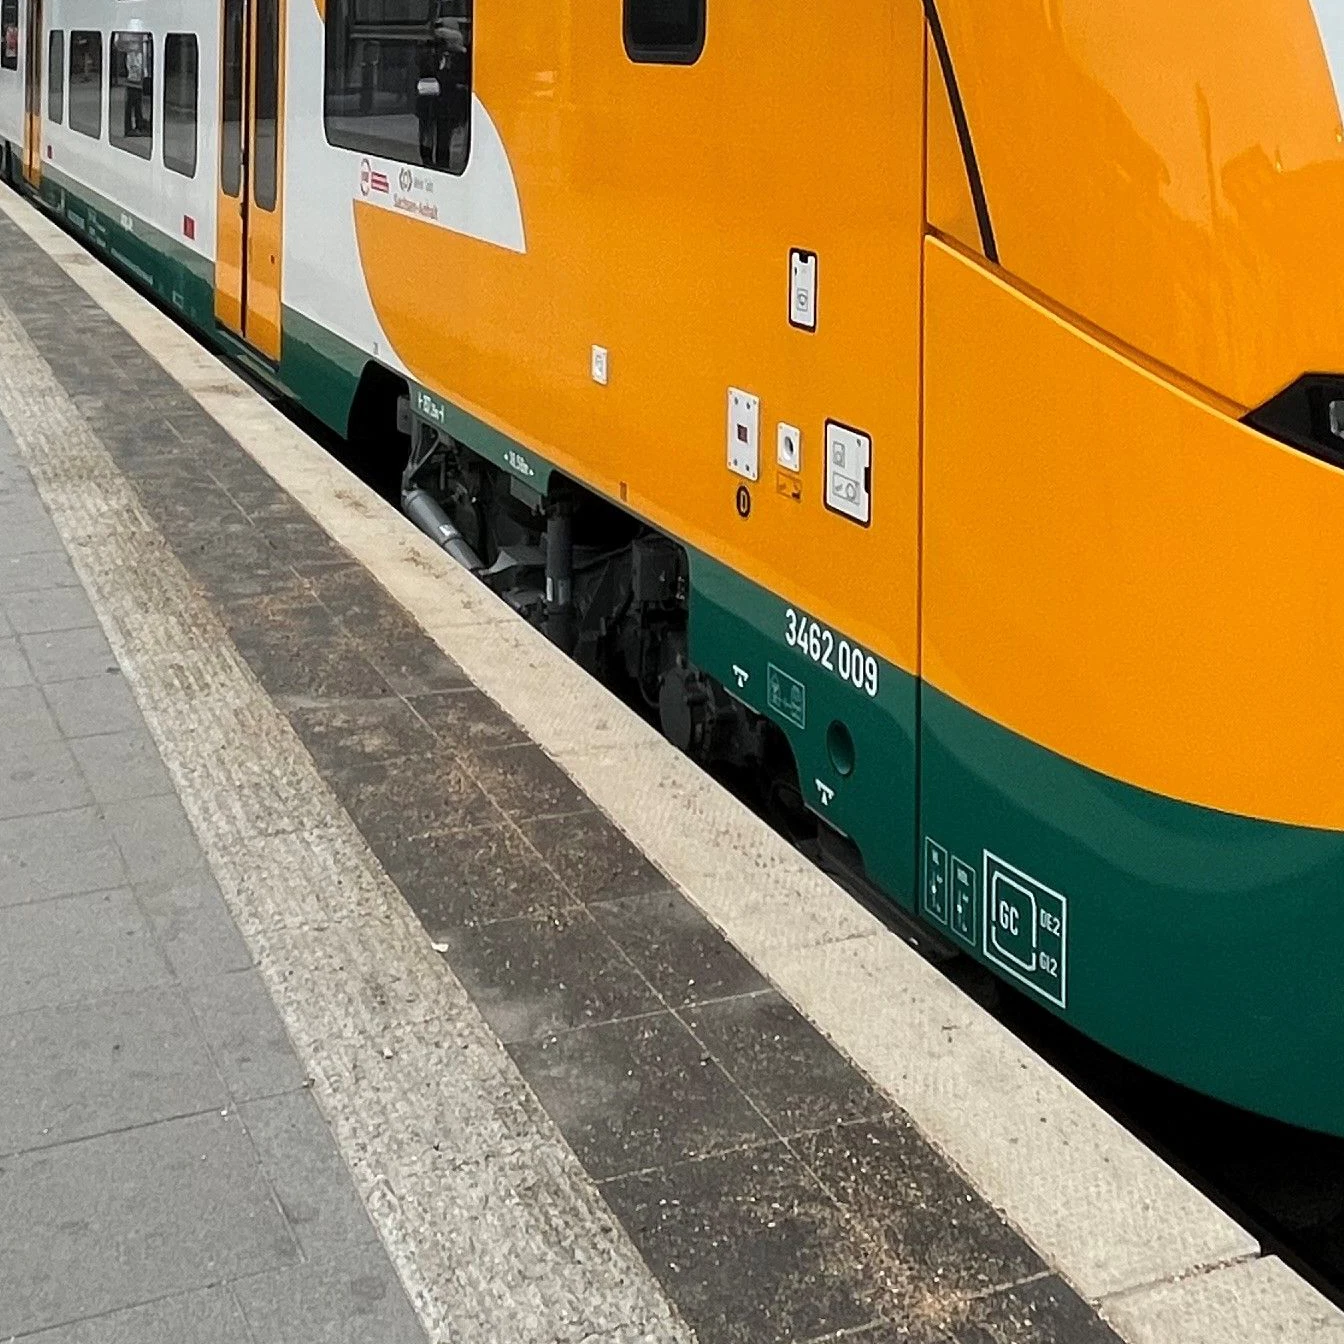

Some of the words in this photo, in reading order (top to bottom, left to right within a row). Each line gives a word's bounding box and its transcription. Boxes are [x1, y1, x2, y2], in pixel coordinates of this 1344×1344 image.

[785, 608, 834, 671] 3462
[838, 640, 878, 697] 009
[999, 900, 1019, 936] GC
